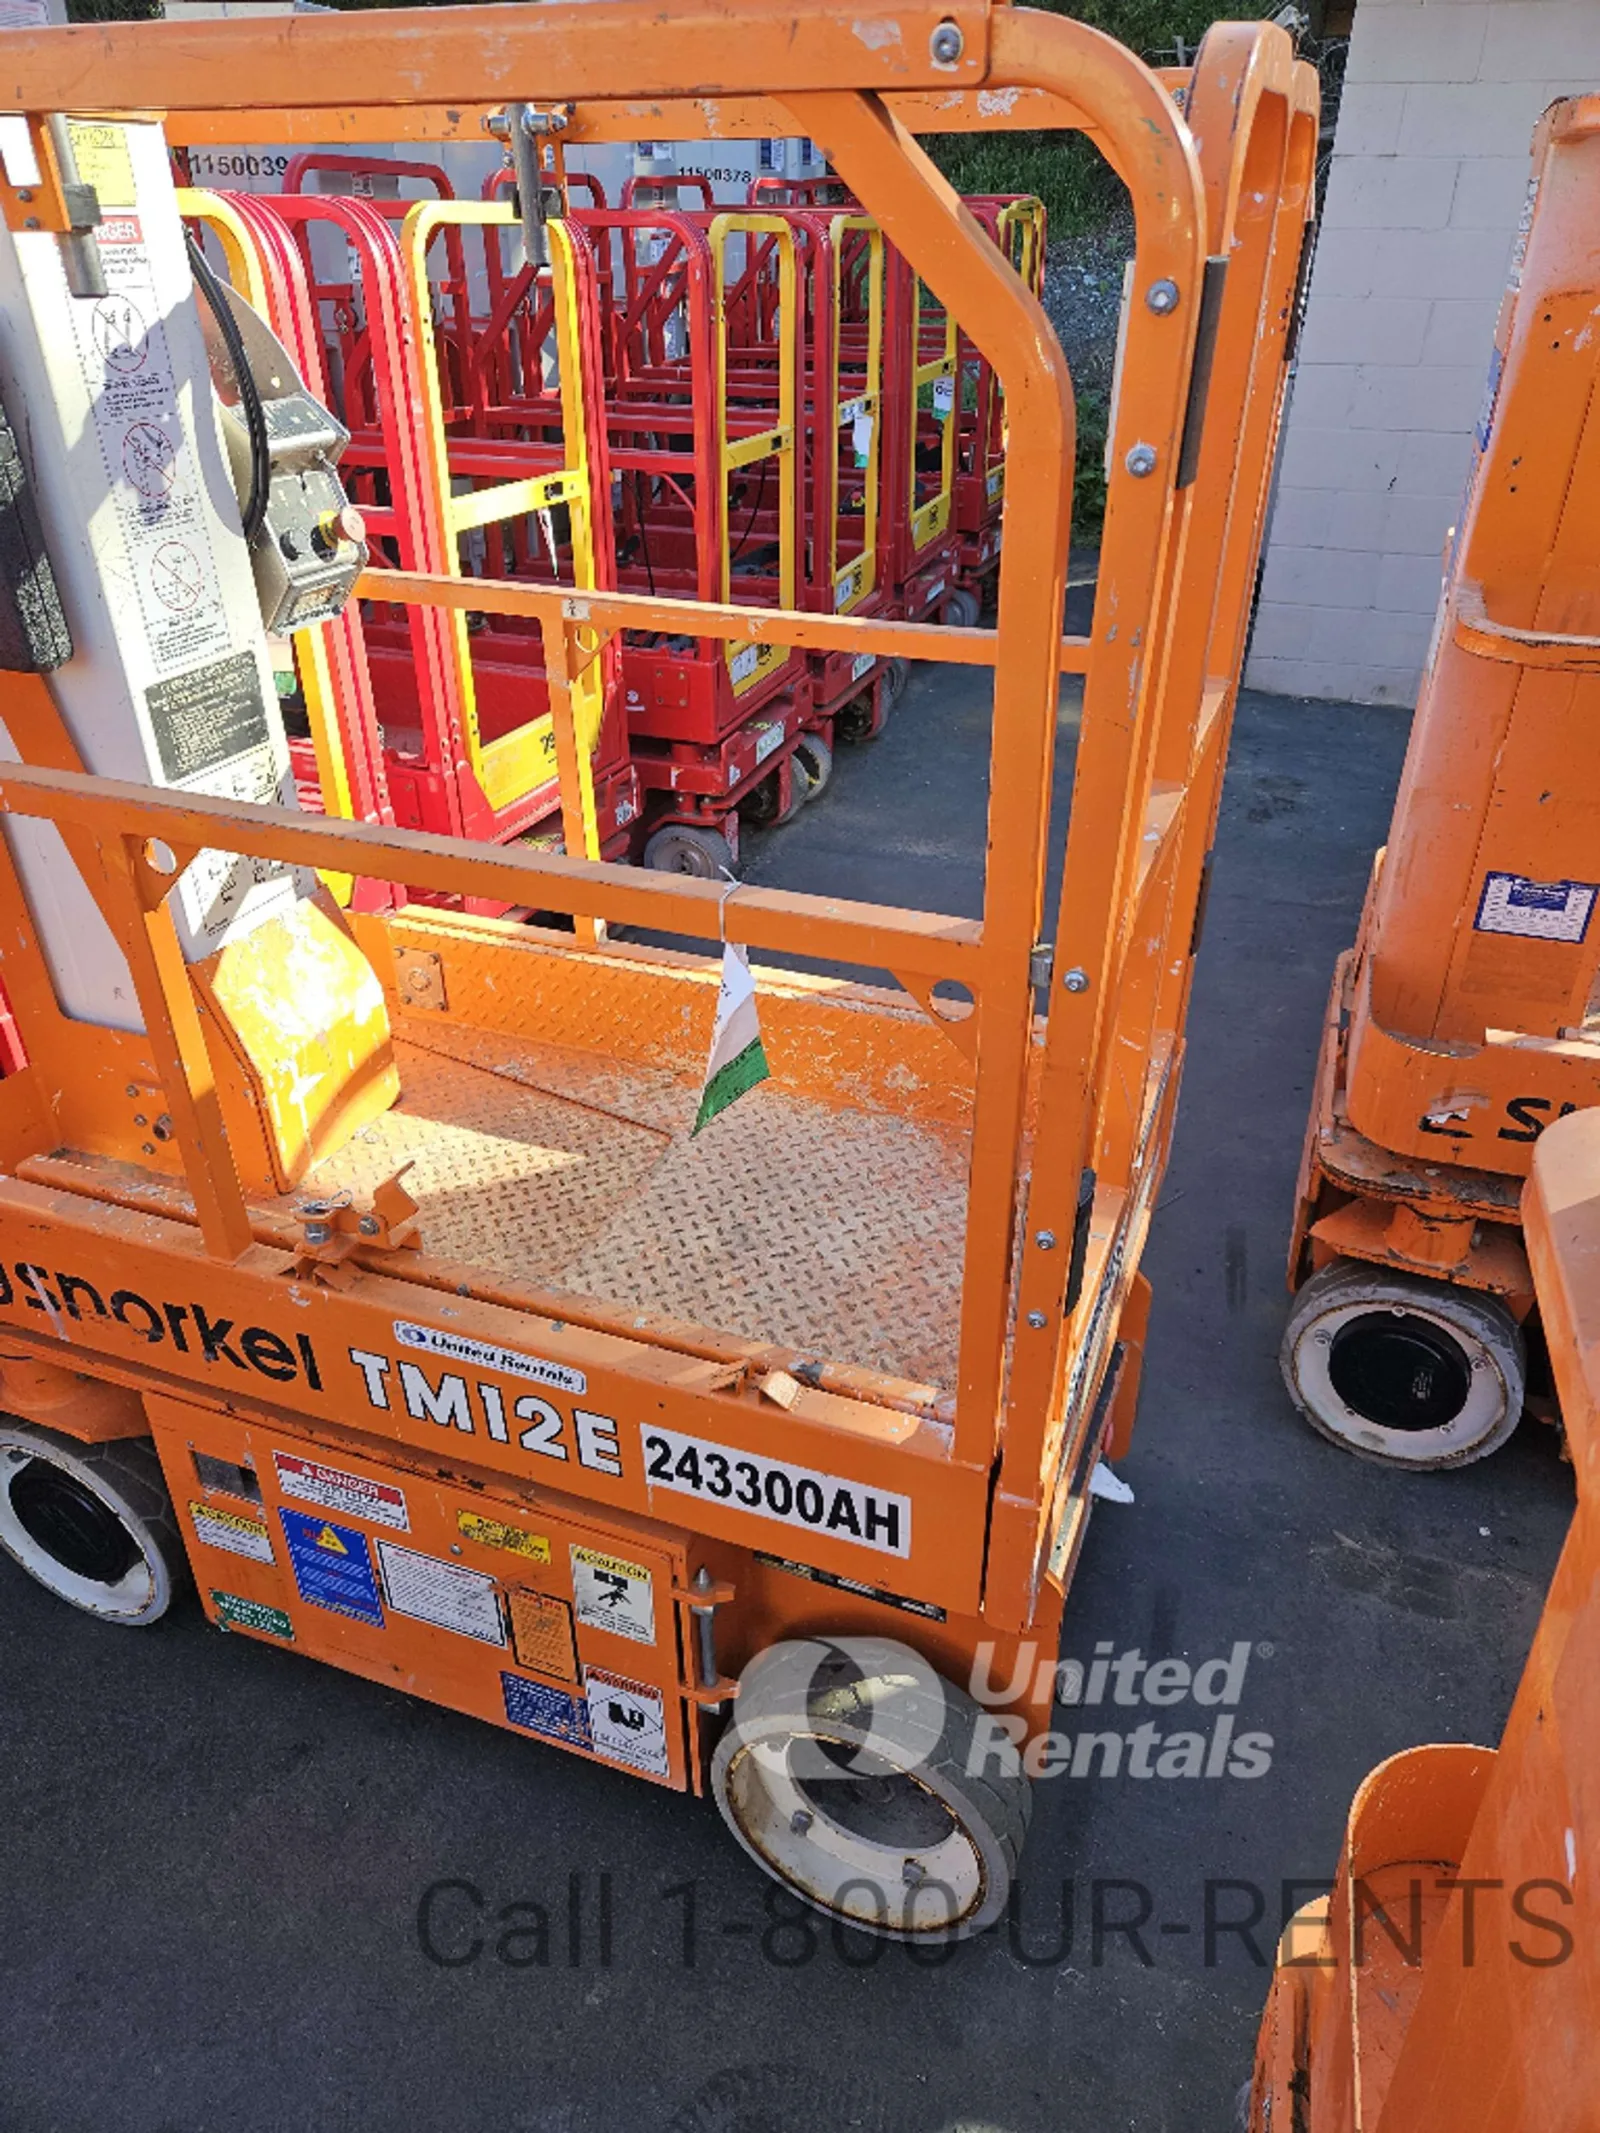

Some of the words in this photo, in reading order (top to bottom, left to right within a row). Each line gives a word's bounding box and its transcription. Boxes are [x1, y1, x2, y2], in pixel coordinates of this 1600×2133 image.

[431, 1335, 495, 1363] United
[348, 1347, 623, 1477] TM12E
[645, 1435, 899, 1549] 243300AH
